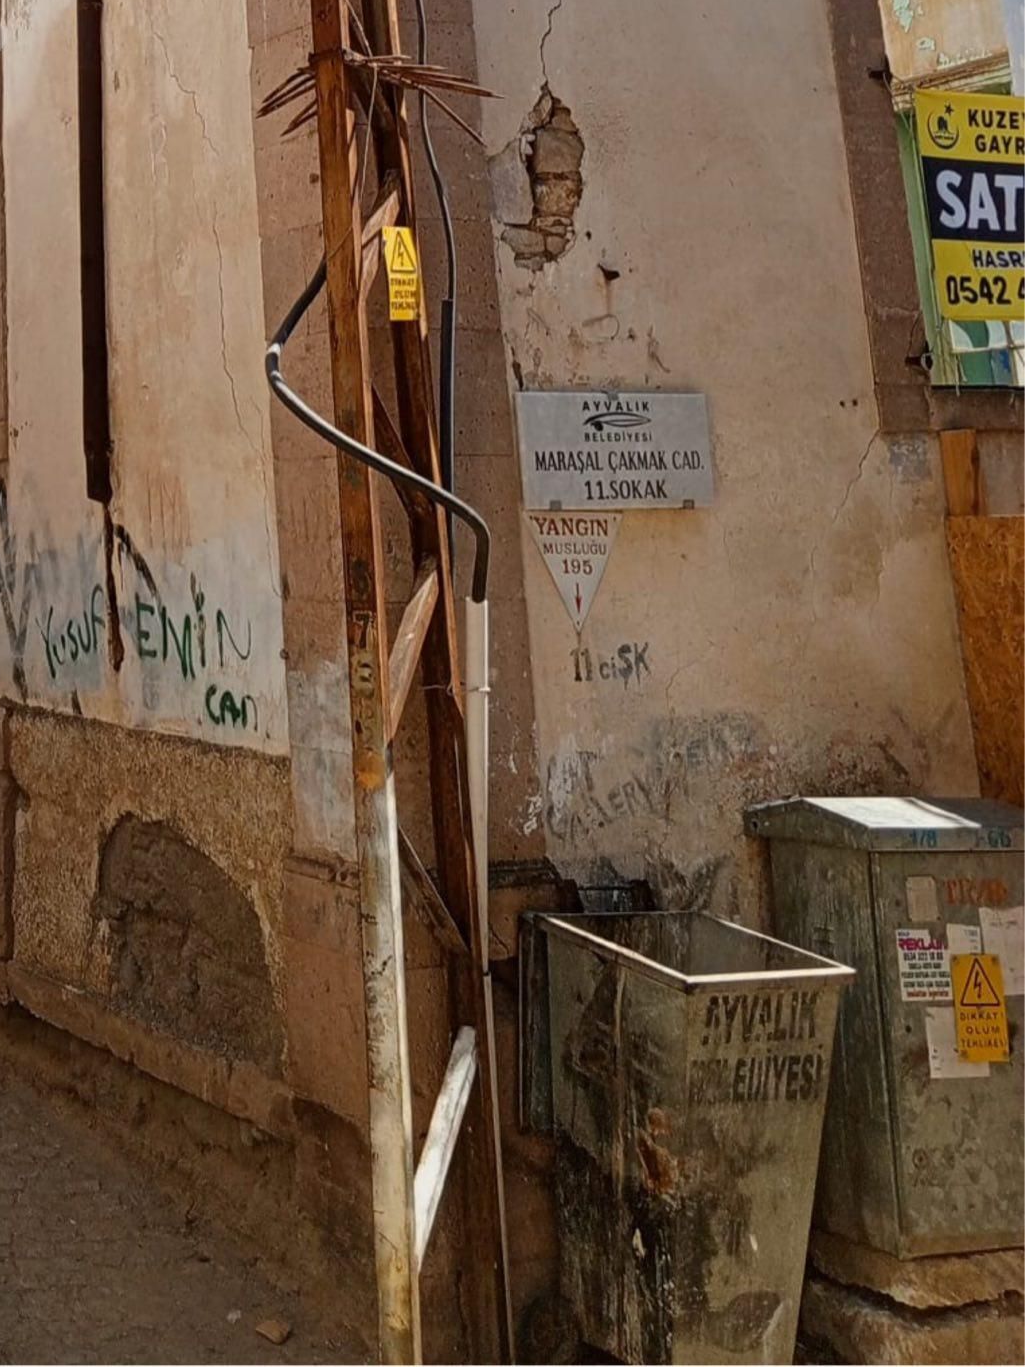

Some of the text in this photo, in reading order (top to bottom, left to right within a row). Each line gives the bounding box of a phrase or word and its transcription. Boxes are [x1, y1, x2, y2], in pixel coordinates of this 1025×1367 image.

[973, 251, 1025, 268] HASR
[947, 276, 1011, 306] 0542
[582, 401, 649, 411] AYVALIK
[584, 431, 652, 442] BELEDİYESİ
[535, 450, 704, 474] MARAŞAL ÇAKMAK CAD.
[535, 518, 609, 537] YANGIN
[543, 541, 607, 555] MUSLUĞU
[562, 559, 593, 575] 195
